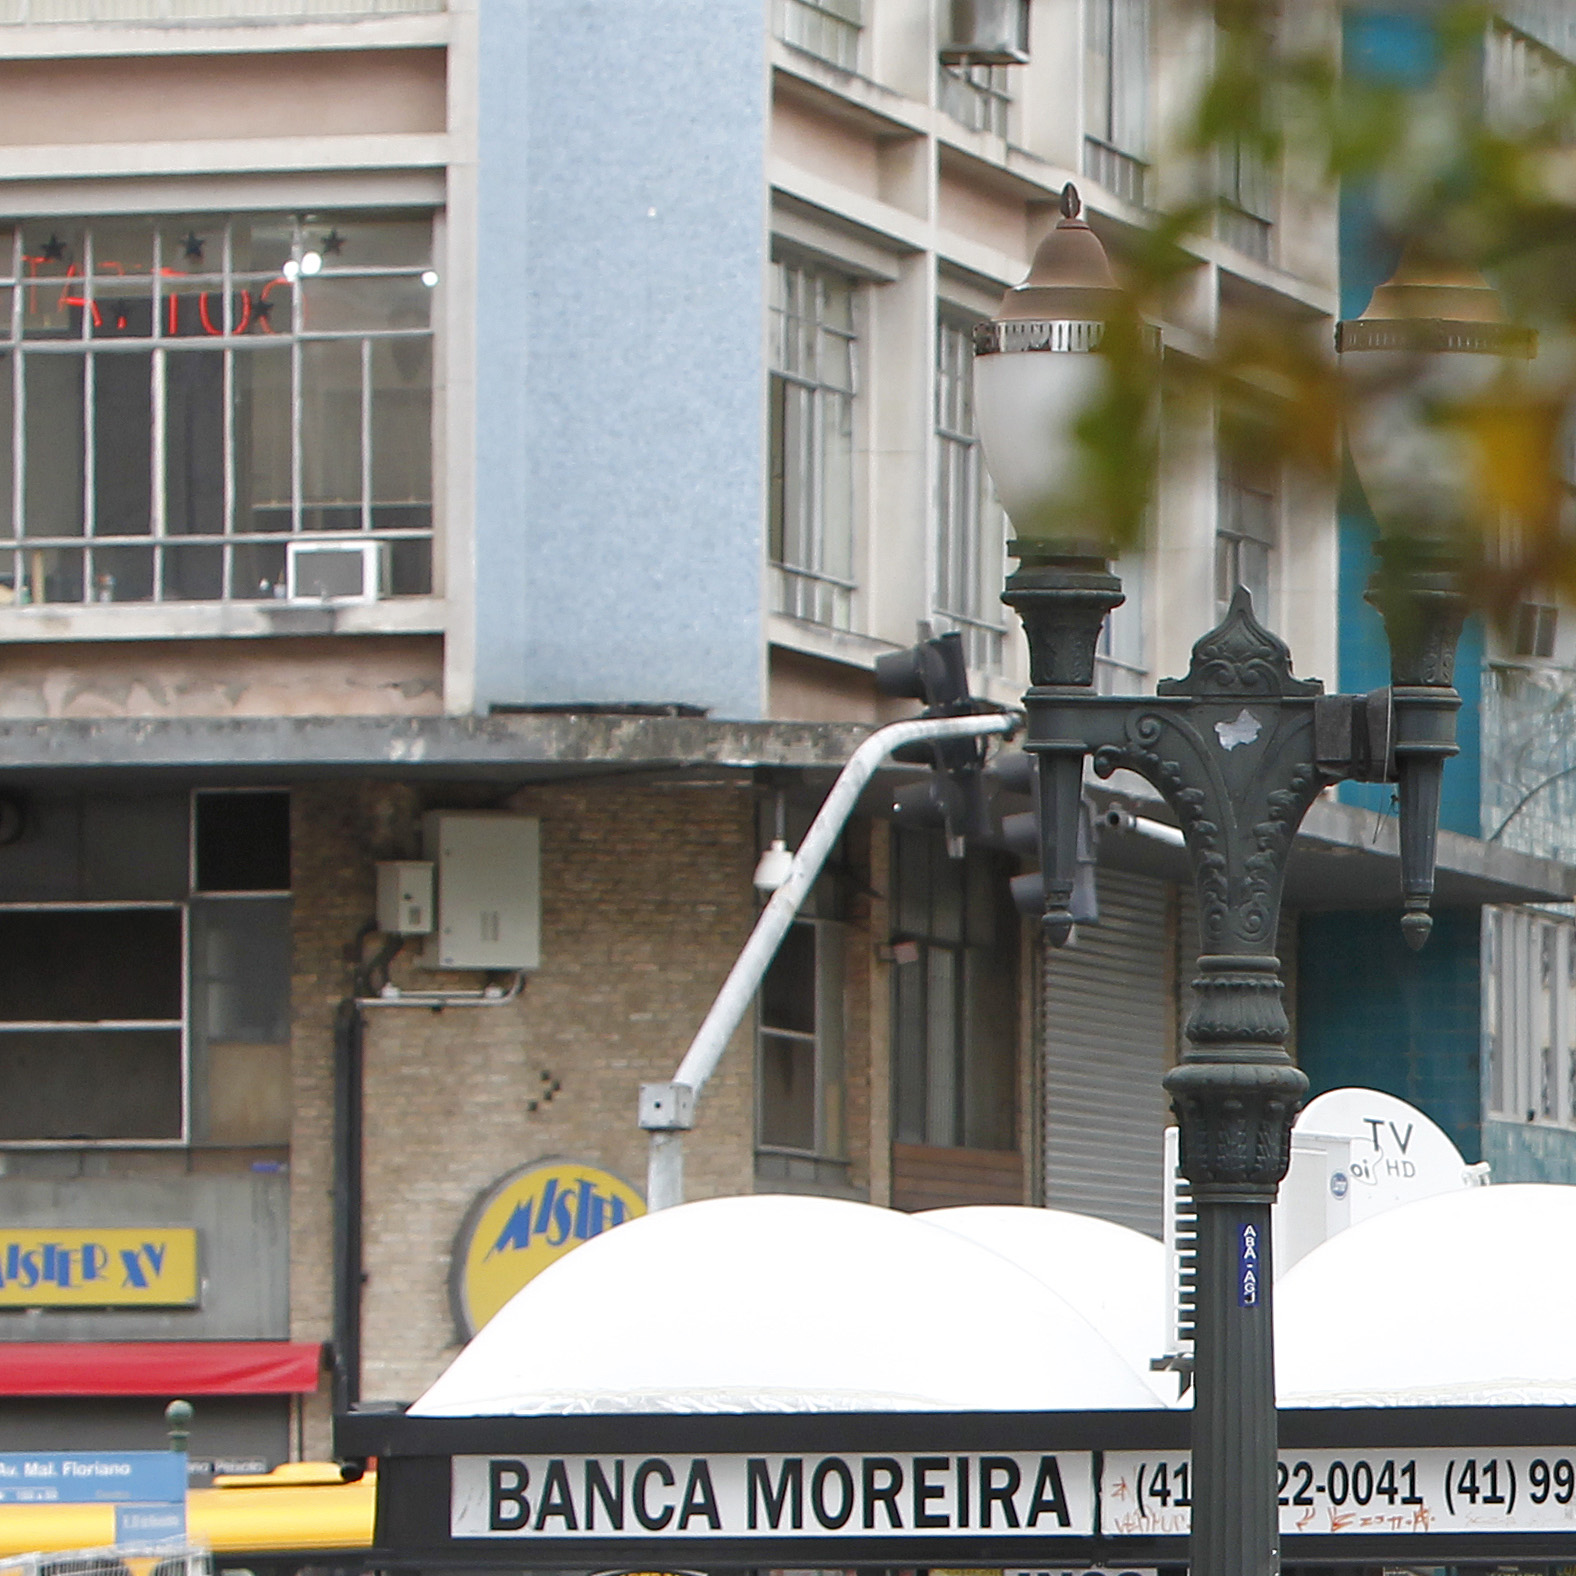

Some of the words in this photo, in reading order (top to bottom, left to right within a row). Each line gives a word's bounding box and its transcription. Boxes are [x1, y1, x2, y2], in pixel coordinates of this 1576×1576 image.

[1363, 1117, 1413, 1155] TV
[1350, 1160, 1370, 1179] oi
[1386, 1158, 1416, 1178] HD
[0, 1242, 109, 1289] ISTER
[119, 1242, 166, 1289] XV
[24, 1462, 57, 1477] Mal.
[62, 1461, 132, 1477] Floriano
[1136, 1461, 1191, 1518] (41
[1443, 1458, 1517, 1515] (41)
[489, 1459, 723, 1532] BANCA
[746, 1457, 1072, 1530] MOREIRA
